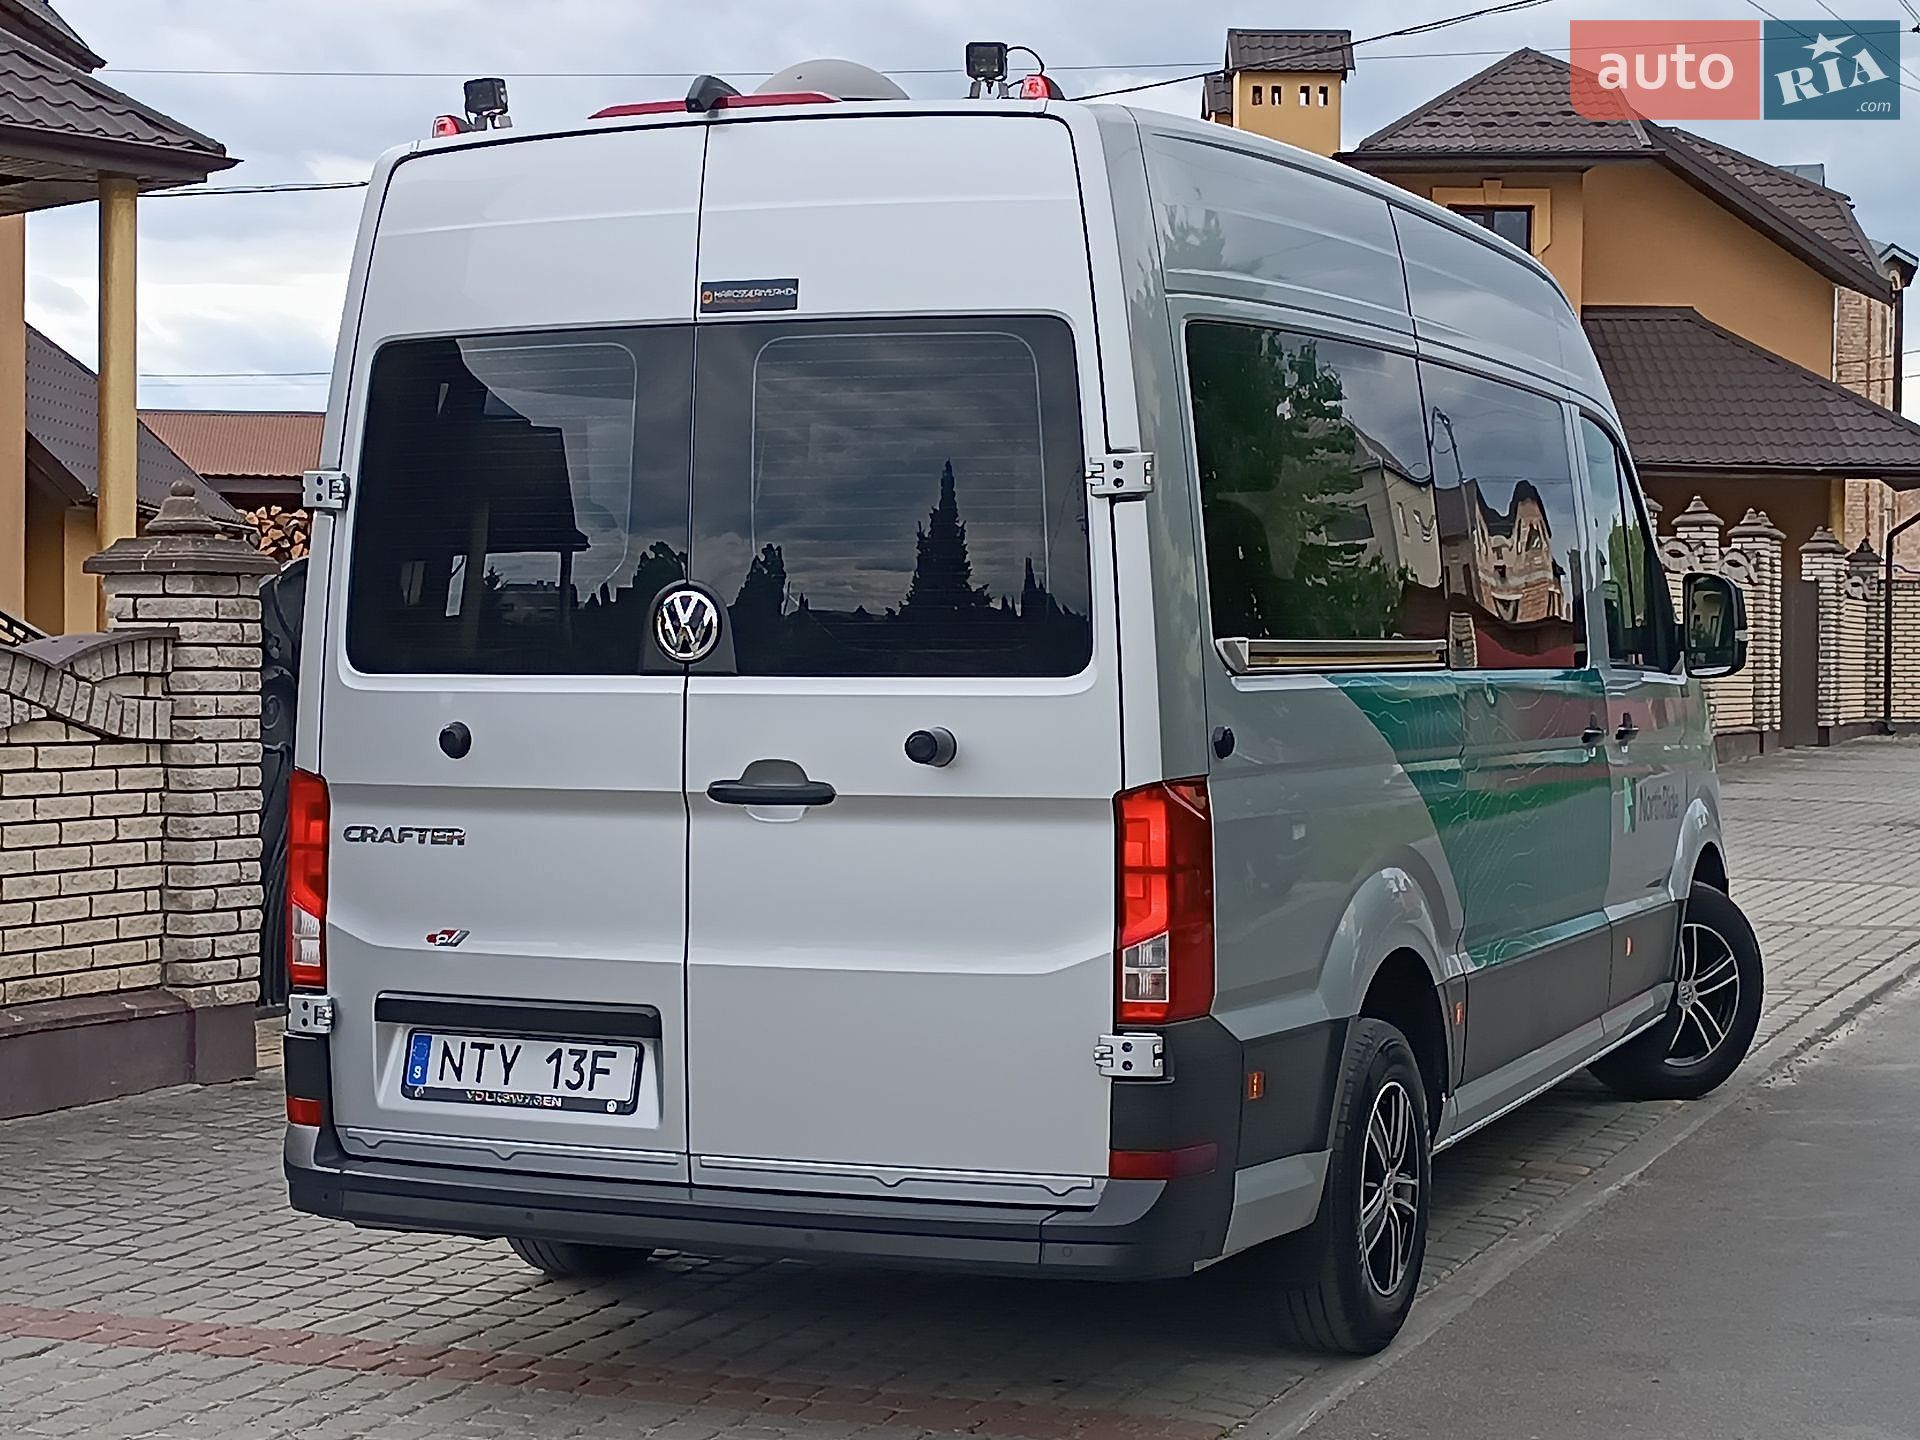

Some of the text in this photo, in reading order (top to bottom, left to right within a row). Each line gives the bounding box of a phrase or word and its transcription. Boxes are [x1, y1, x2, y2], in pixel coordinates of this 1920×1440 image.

[343, 825, 466, 846] CRAFTER
[412, 1065, 422, 1079] S
[438, 1039, 617, 1092] NTY 13F
